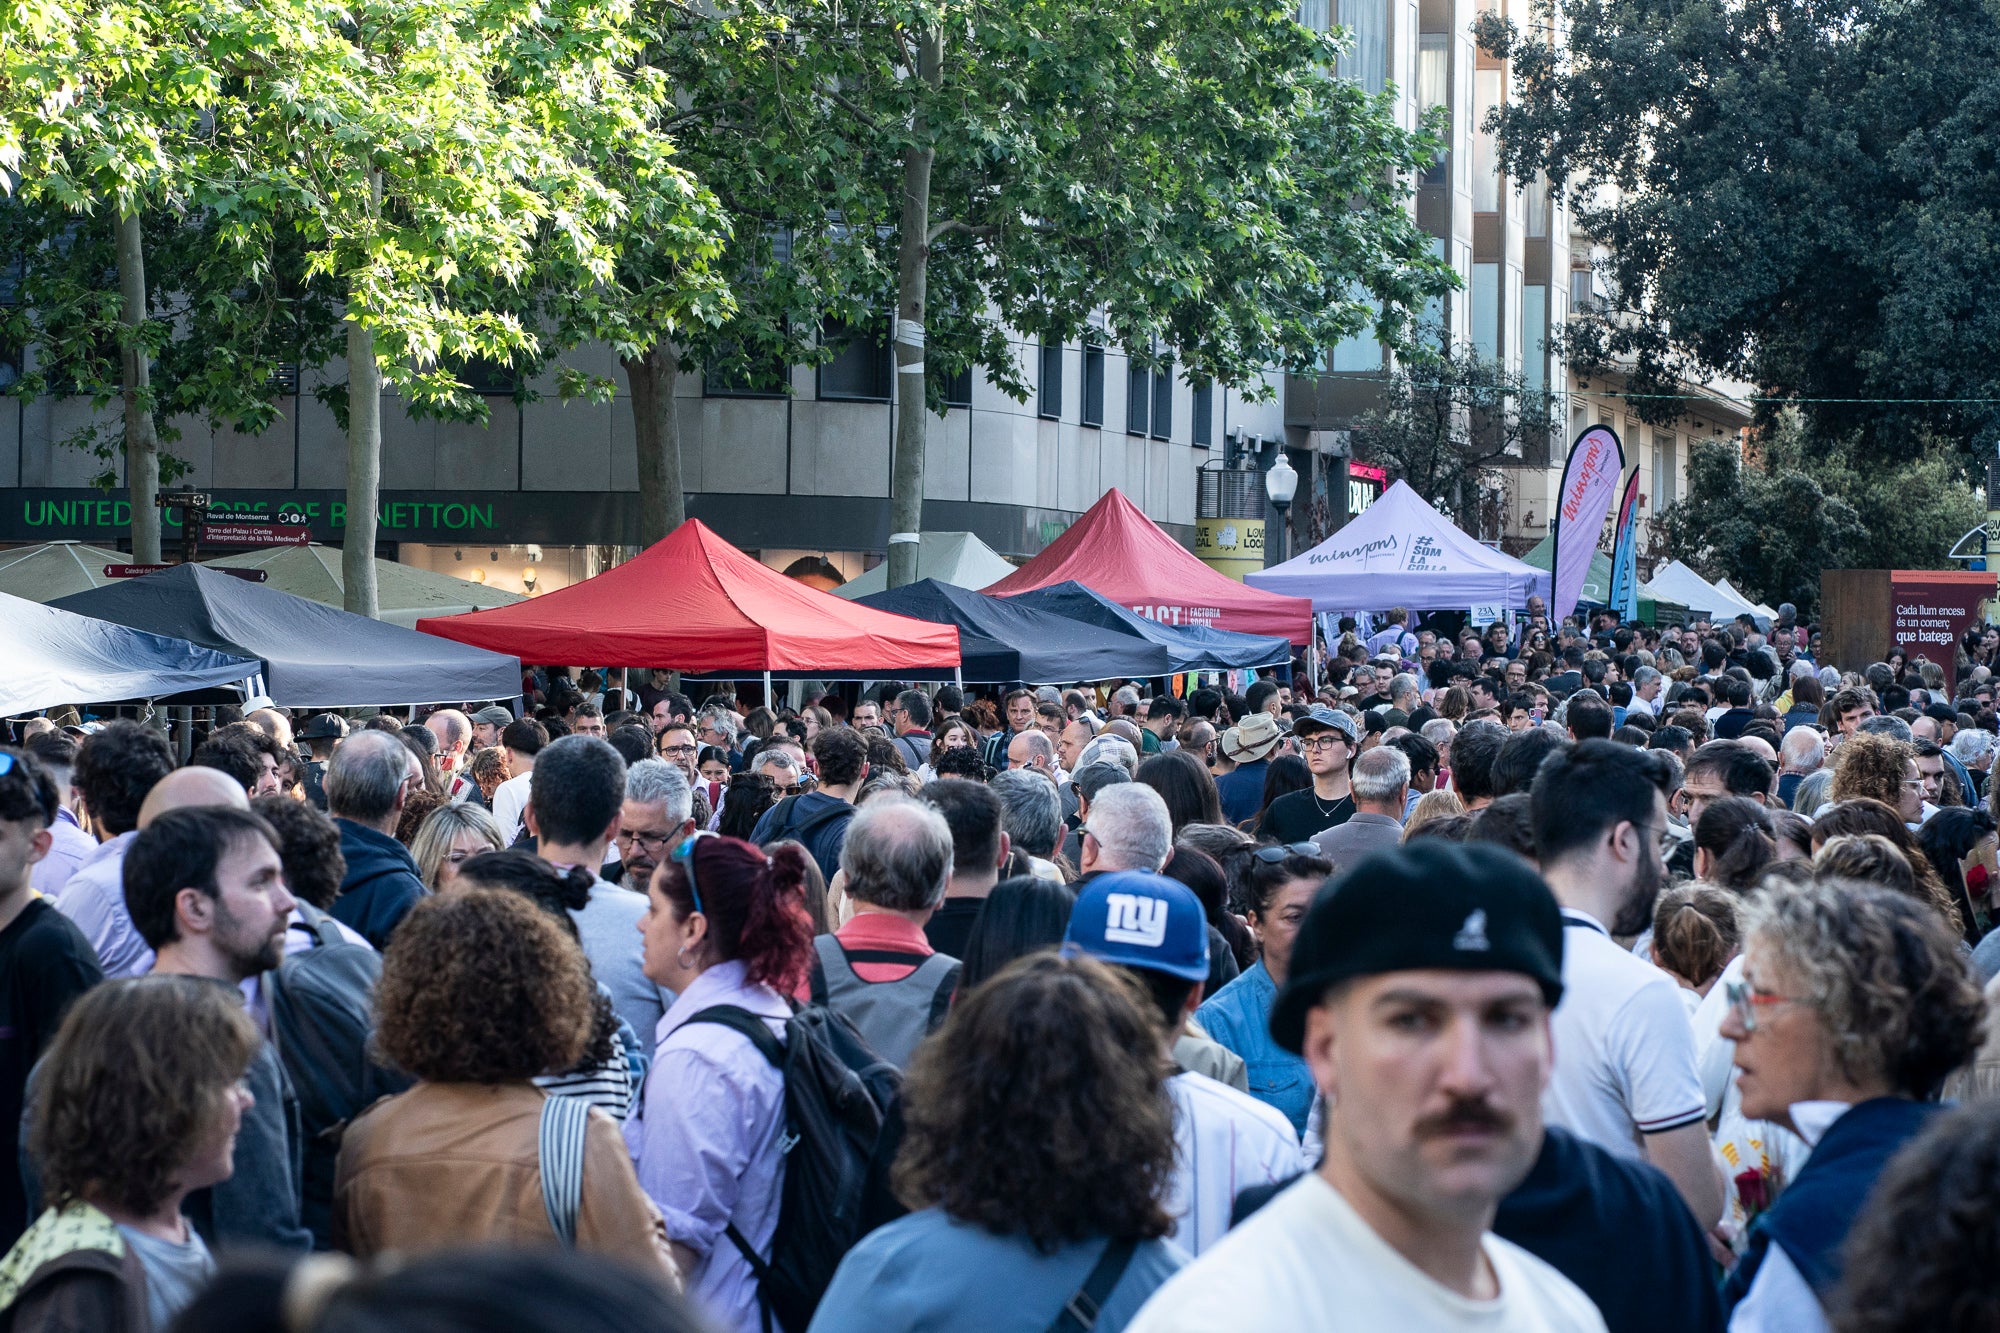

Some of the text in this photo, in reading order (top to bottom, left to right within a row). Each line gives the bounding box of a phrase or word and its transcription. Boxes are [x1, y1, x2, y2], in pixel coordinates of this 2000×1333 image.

[24, 501, 132, 526] UNITED
[207, 512, 224, 520] Raval
[235, 513, 270, 521] Montserrat
[206, 534, 247, 543] d'Interpretació
[1416, 536, 1434, 546] #
[1412, 545, 1442, 557] SOM
[1410, 555, 1426, 564] LA
[1190, 607, 1221, 618] FACTORIA
[1896, 604, 1966, 616] Cada llum encesa
[1190, 618, 1212, 628] SOCIAL
[1896, 616, 1906, 627] és
[1920, 619, 1950, 630] comerç
[1896, 629, 1954, 646] que batega
